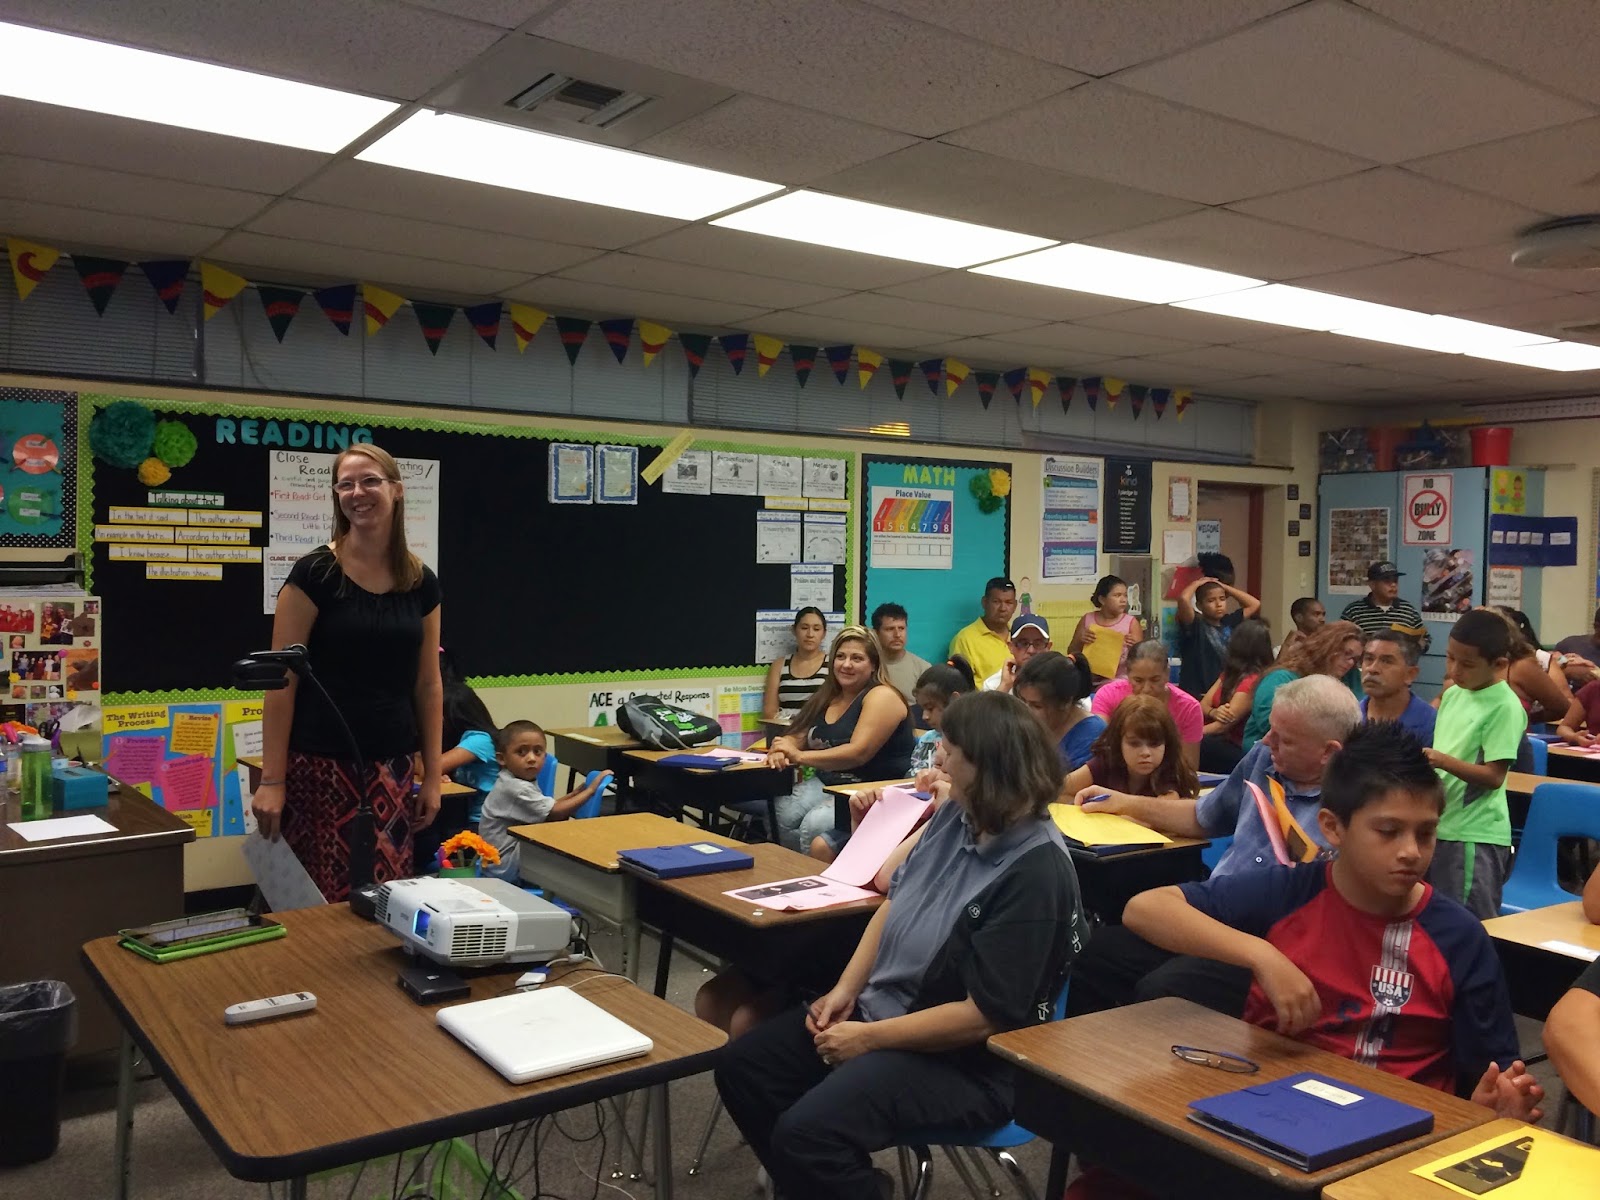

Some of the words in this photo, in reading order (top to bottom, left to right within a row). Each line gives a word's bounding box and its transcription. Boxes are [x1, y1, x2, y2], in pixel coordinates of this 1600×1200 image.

[216, 418, 373, 450] READING
[276, 451, 309, 463] Close
[299, 465, 330, 475] Read
[1046, 461, 1074, 473] Discussion
[903, 465, 956, 486] MATH
[1423, 478, 1434, 489] NO
[154, 493, 179, 505] Talking
[180, 494, 201, 505] about
[895, 489, 913, 498] Place
[914, 490, 932, 498] Value
[1415, 503, 1442, 516] BULLY
[1418, 531, 1437, 540] ZONE
[1423, 612, 1459, 620] DIVERSI
[590, 692, 613, 707] ACE
[675, 690, 711, 703] Response
[106, 714, 126, 722] The
[128, 710, 165, 719] Writing
[117, 719, 156, 728] Process
[1378, 981, 1403, 998] USA
